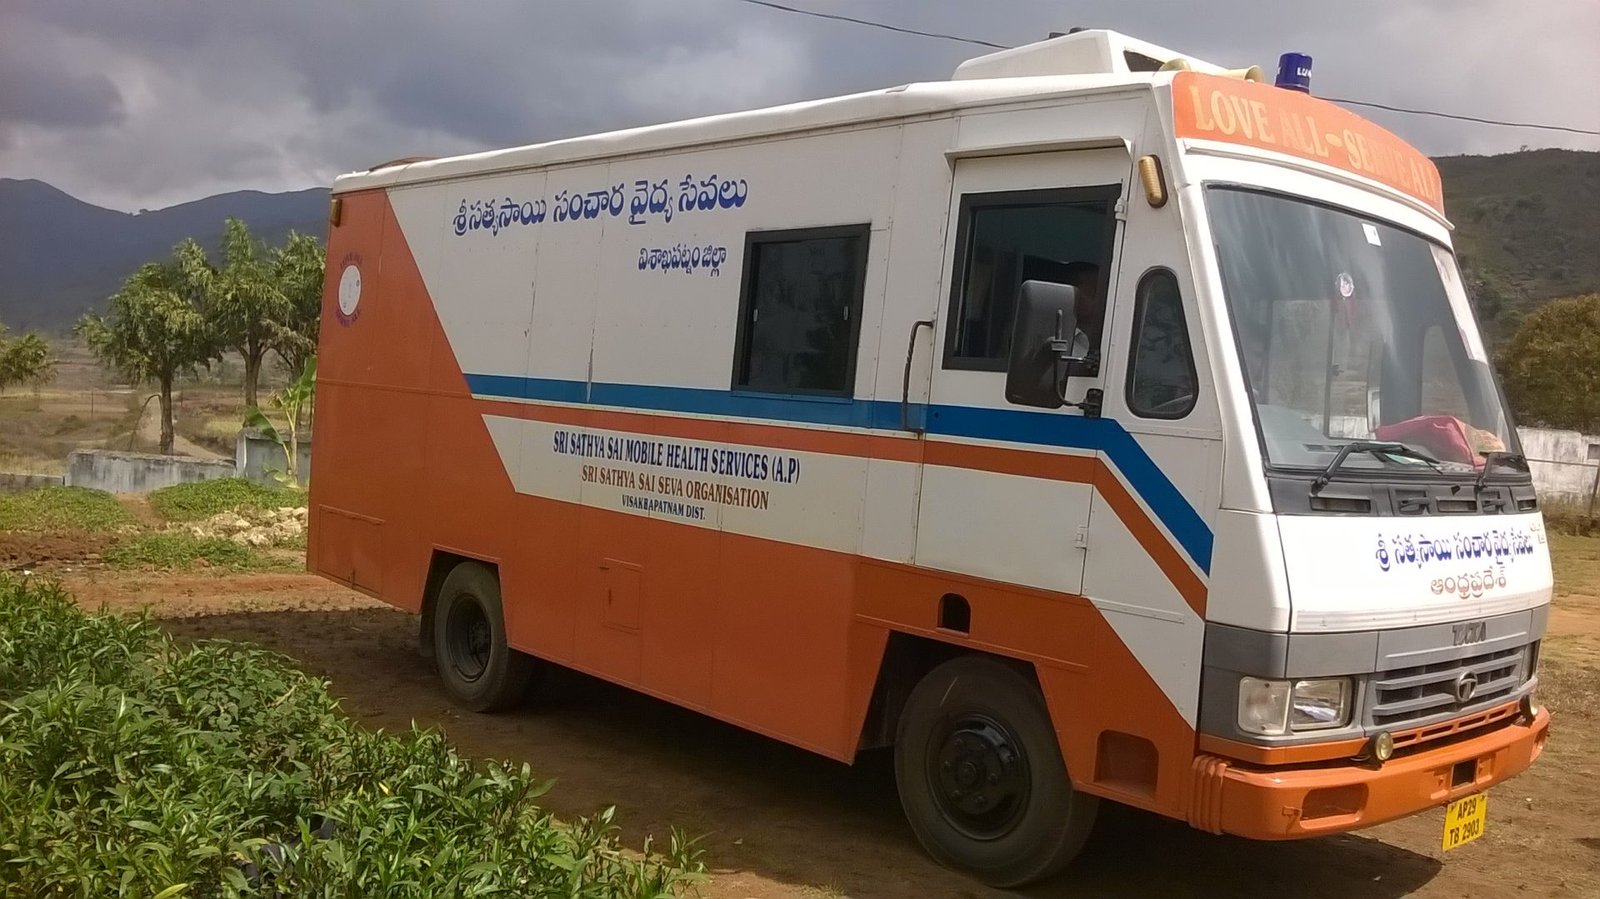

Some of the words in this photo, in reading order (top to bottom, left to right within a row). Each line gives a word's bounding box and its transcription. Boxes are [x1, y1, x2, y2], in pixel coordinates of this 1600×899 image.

[1189, 84, 1276, 143] LOVE
[553, 182, 626, 224] సంచార
[628, 179, 674, 226] వైద్య
[678, 173, 749, 213] సేవలు
[553, 430, 569, 454] SRI
[570, 431, 606, 459] SATHYA
[607, 436, 624, 461] SAI
[624, 439, 663, 466] MOBILE
[666, 444, 709, 472] HEALTH
[710, 448, 769, 481] SERVICES
[771, 454, 801, 485] (A.P)
[581, 464, 598, 483] SRI
[599, 467, 636, 490] SATHYA
[638, 472, 655, 493] SAI
[658, 475, 683, 498] SEVA
[686, 480, 770, 511] ORGANISATION
[686, 505, 706, 521] DIST.
[1449, 826, 1460, 846] TB
[1462, 818, 1480, 841] 2903
[1456, 797, 1477, 822] AP29
